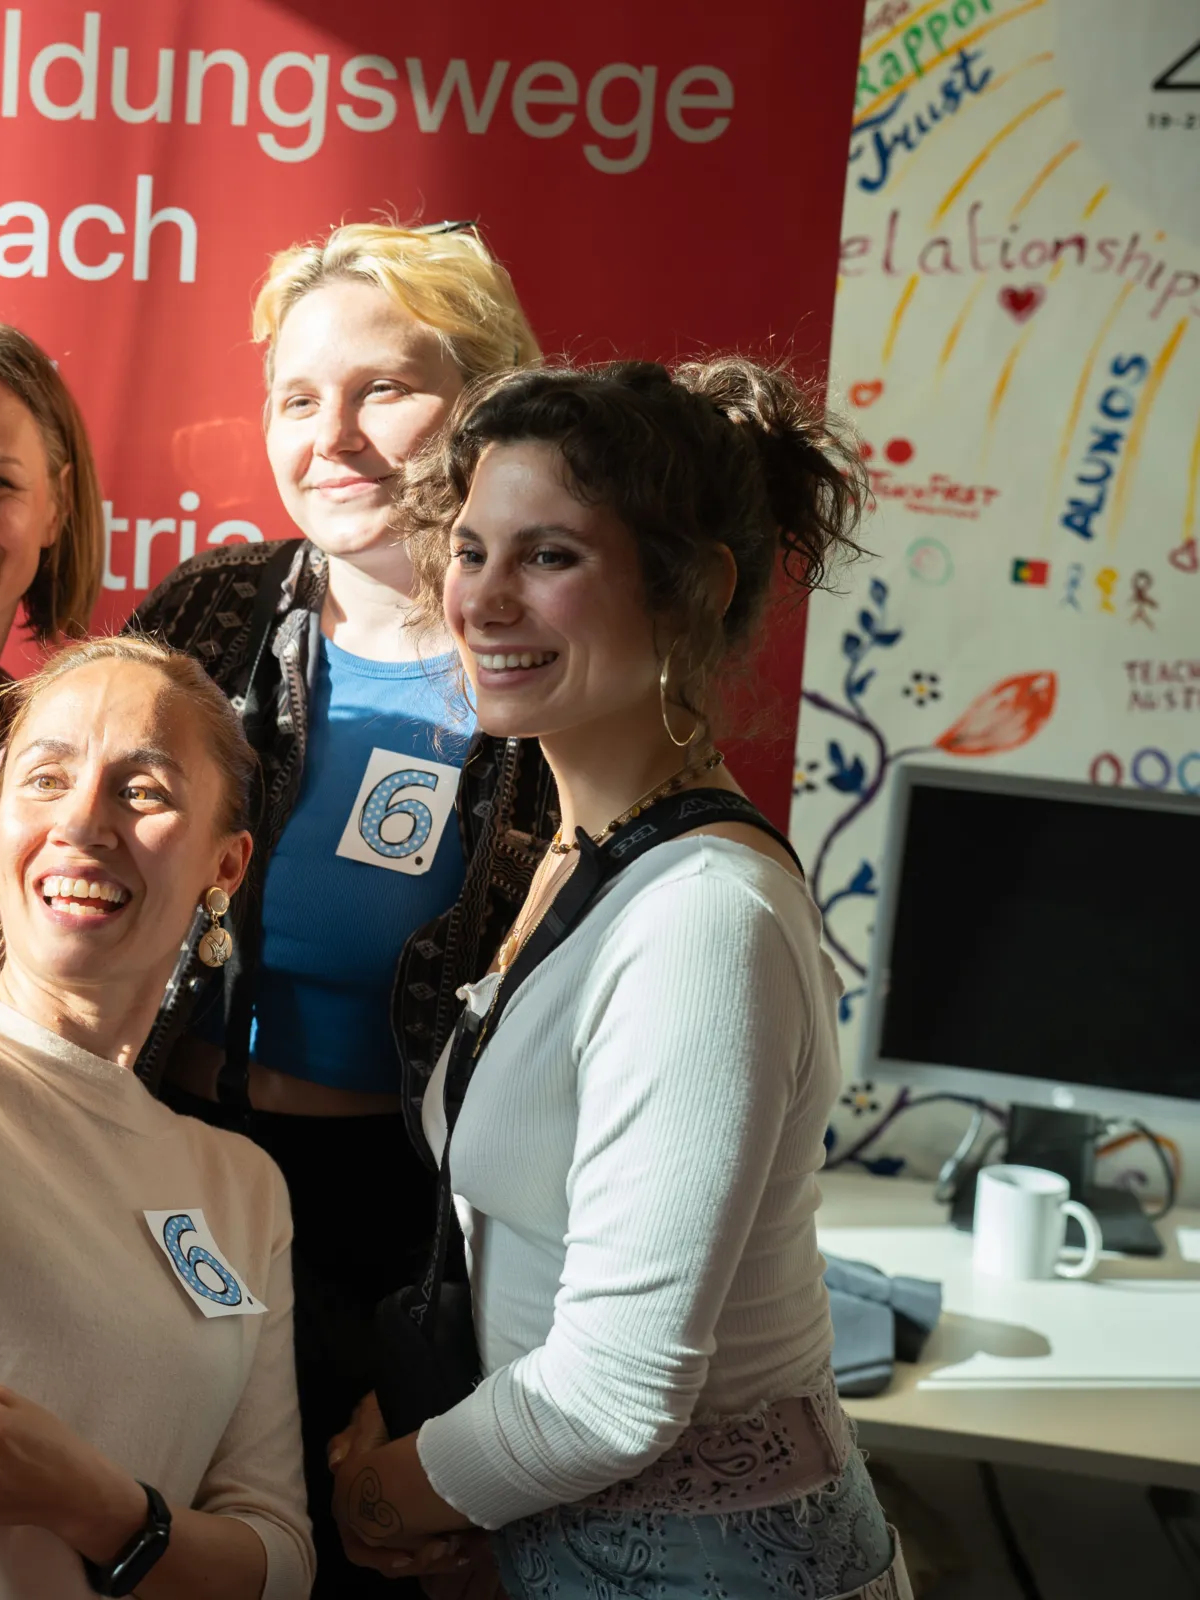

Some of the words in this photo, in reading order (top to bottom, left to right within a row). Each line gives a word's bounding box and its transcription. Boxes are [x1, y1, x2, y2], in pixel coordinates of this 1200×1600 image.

[851, 47, 993, 193] Trust
[840, 201, 1200, 320] elationship
[1060, 353, 1149, 542] ALUNOS
